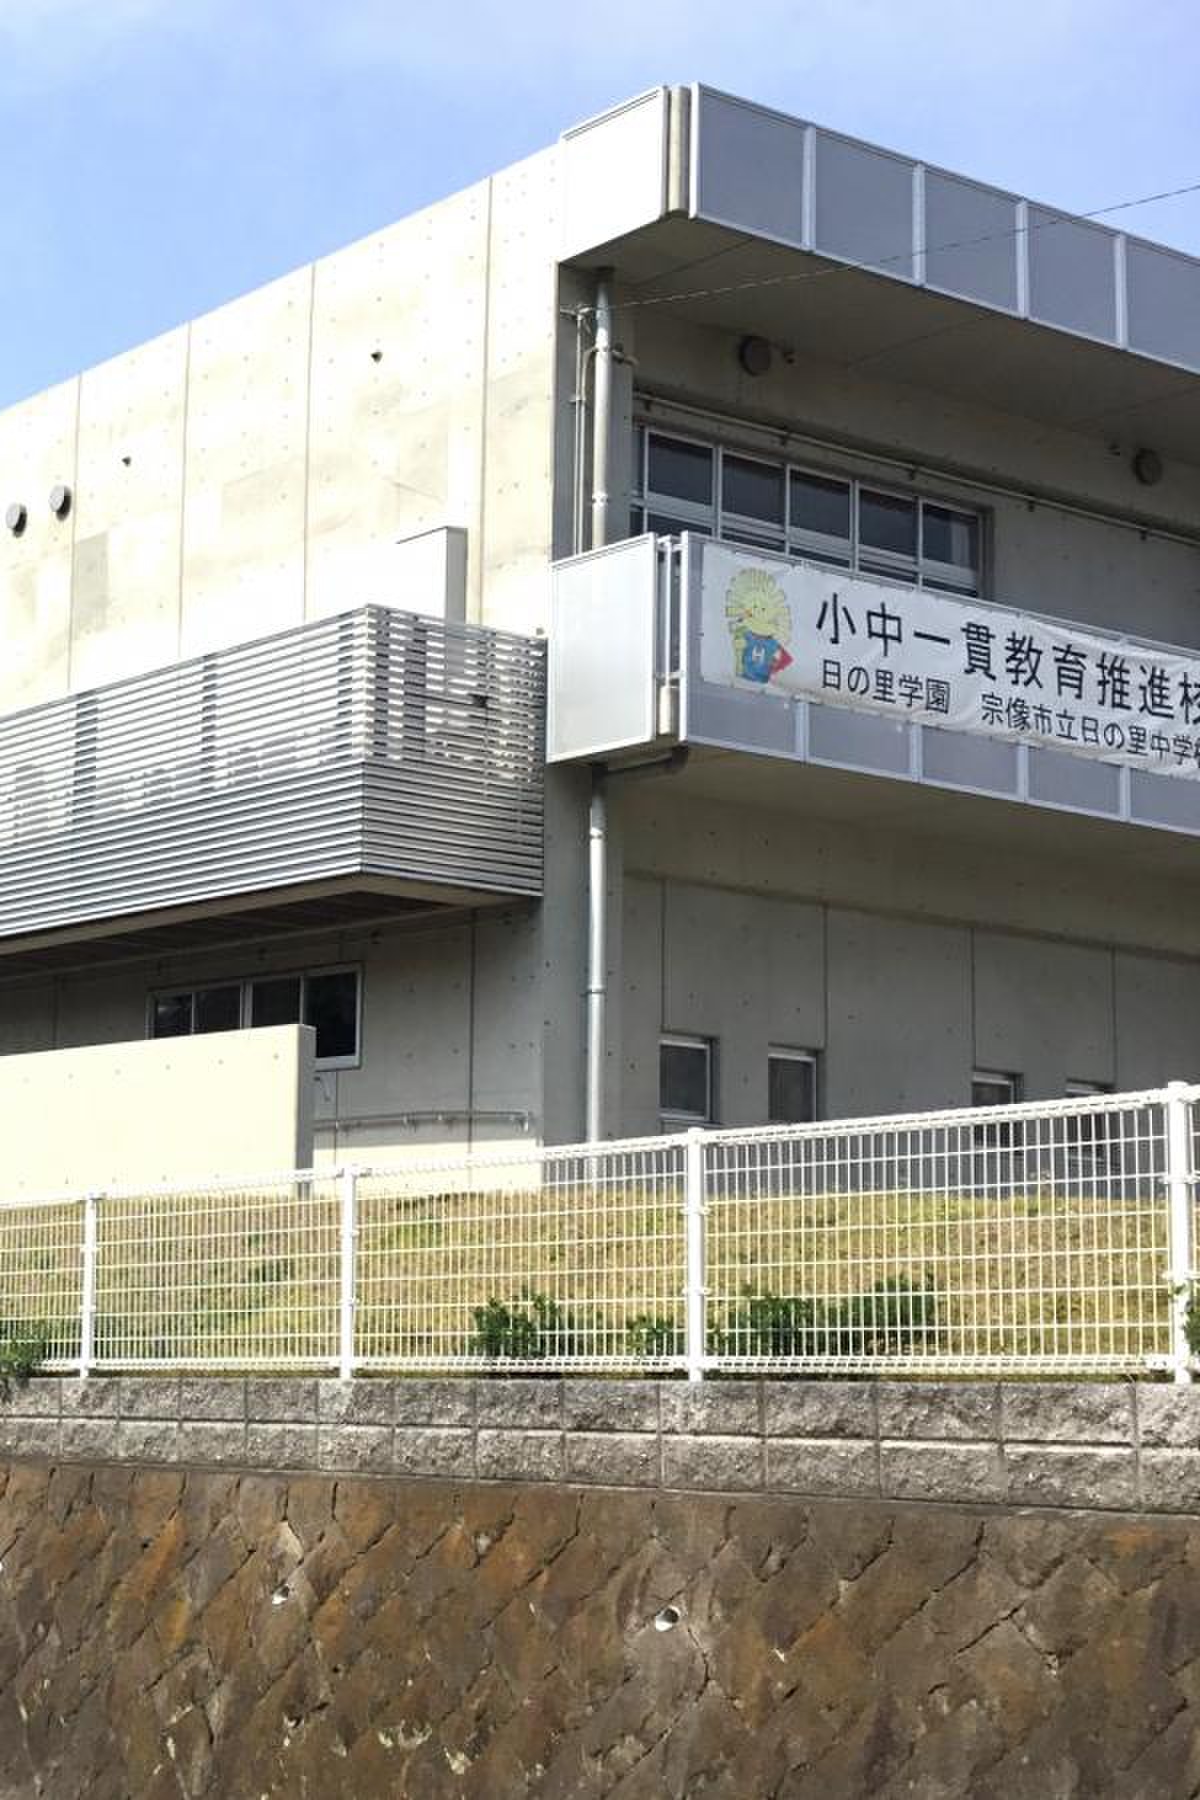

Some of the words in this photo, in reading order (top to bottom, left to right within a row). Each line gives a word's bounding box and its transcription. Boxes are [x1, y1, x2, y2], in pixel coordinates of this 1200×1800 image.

[821, 659, 951, 715] 日の里学園
